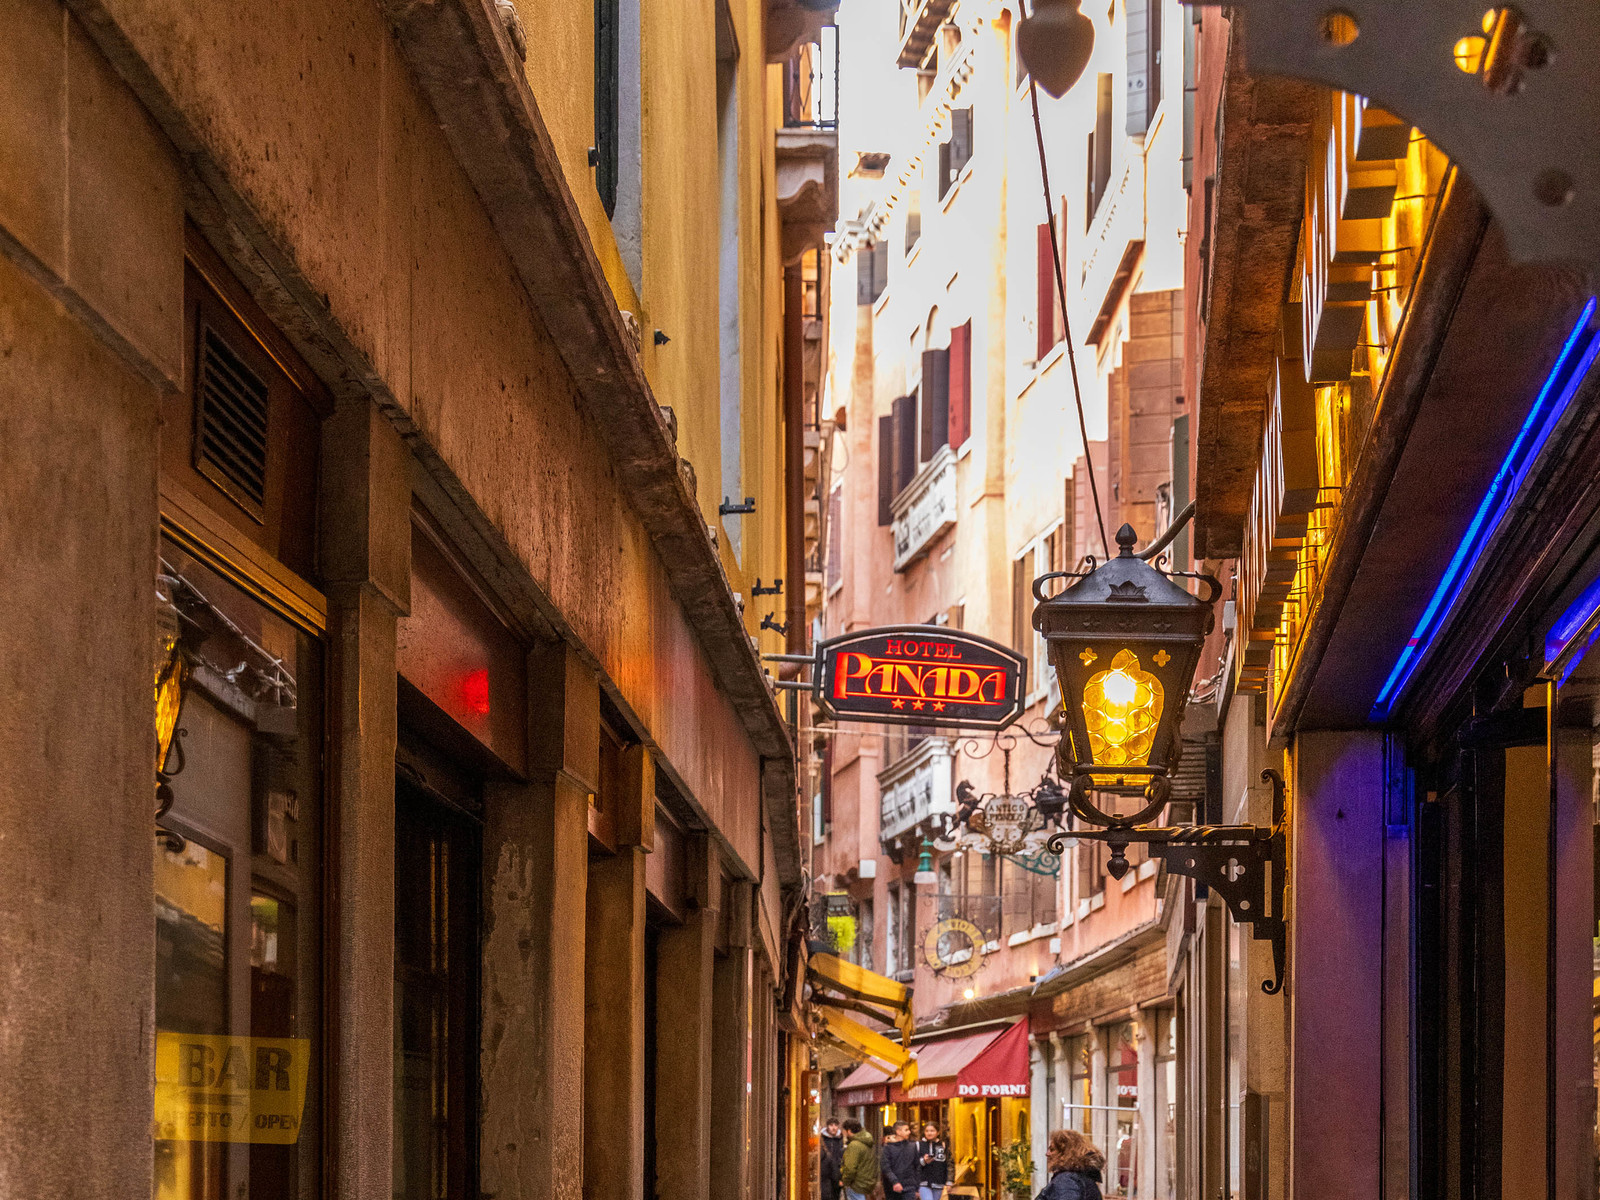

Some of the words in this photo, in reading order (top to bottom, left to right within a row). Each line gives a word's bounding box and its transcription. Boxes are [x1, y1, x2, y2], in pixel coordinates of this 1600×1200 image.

[885, 639, 962, 659] HOTEL
[833, 652, 1006, 702] PANADA
[989, 804, 1025, 812] ANTICO
[178, 1043, 292, 1091] BAR
[958, 1084, 979, 1095] DO
[981, 1084, 1027, 1095] FORNI
[255, 1114, 299, 1129] OPEN
